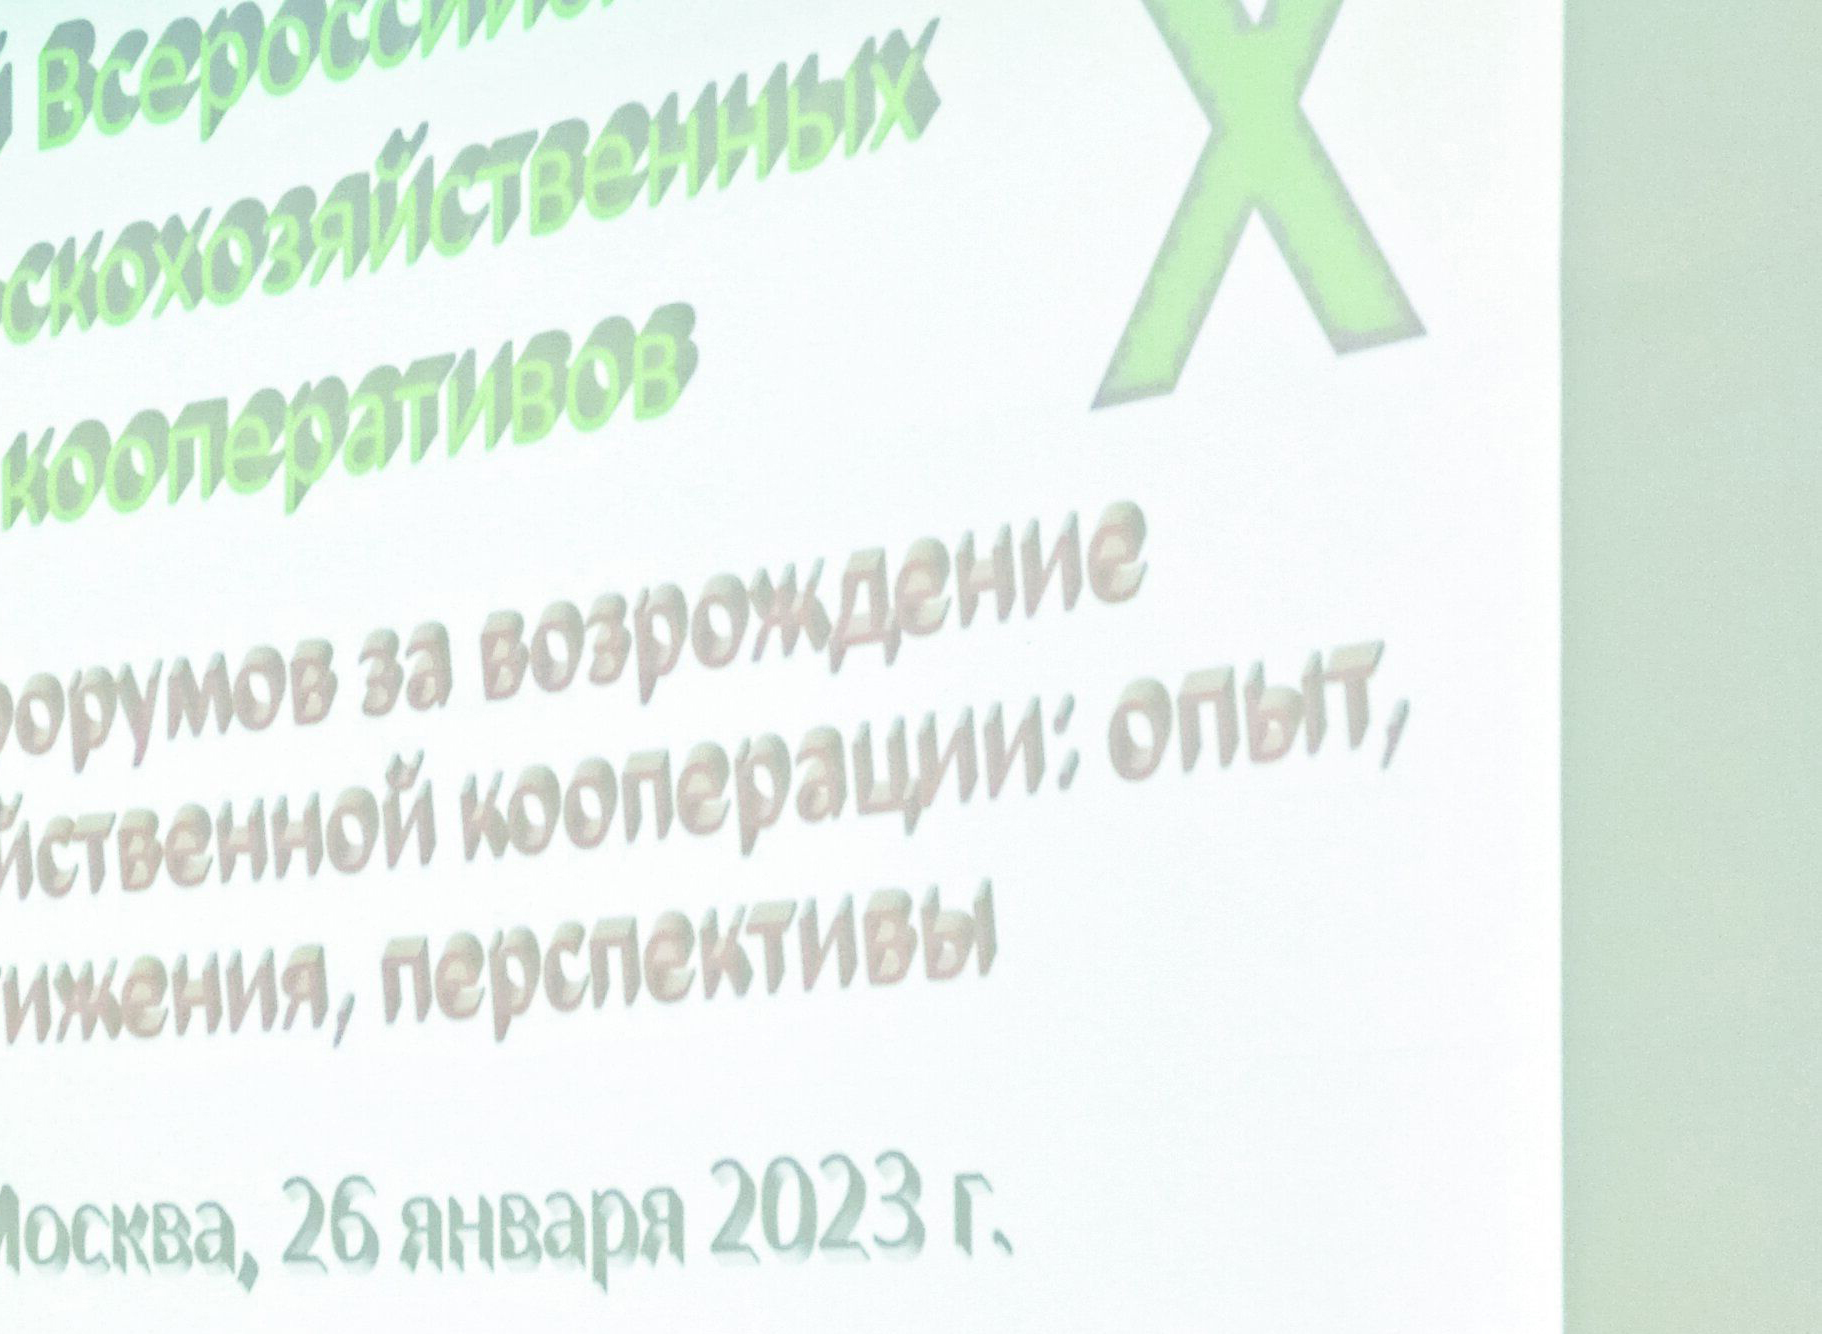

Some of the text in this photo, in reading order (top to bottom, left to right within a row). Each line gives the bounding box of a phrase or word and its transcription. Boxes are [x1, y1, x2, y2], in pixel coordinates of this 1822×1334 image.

[36, 0, 615, 152] Всеросси
[1, 301, 699, 531] кооперативов
[358, 621, 453, 718] за
[480, 500, 1148, 706] возрождение
[459, 694, 1080, 861] кооперации:
[1107, 640, 1410, 781] опыт,
[381, 878, 998, 1043] перспективы
[280, 1174, 380, 1274] 26
[399, 1186, 685, 1294] января
[709, 1149, 927, 1263] 2023
[953, 1171, 1013, 1257] г.
